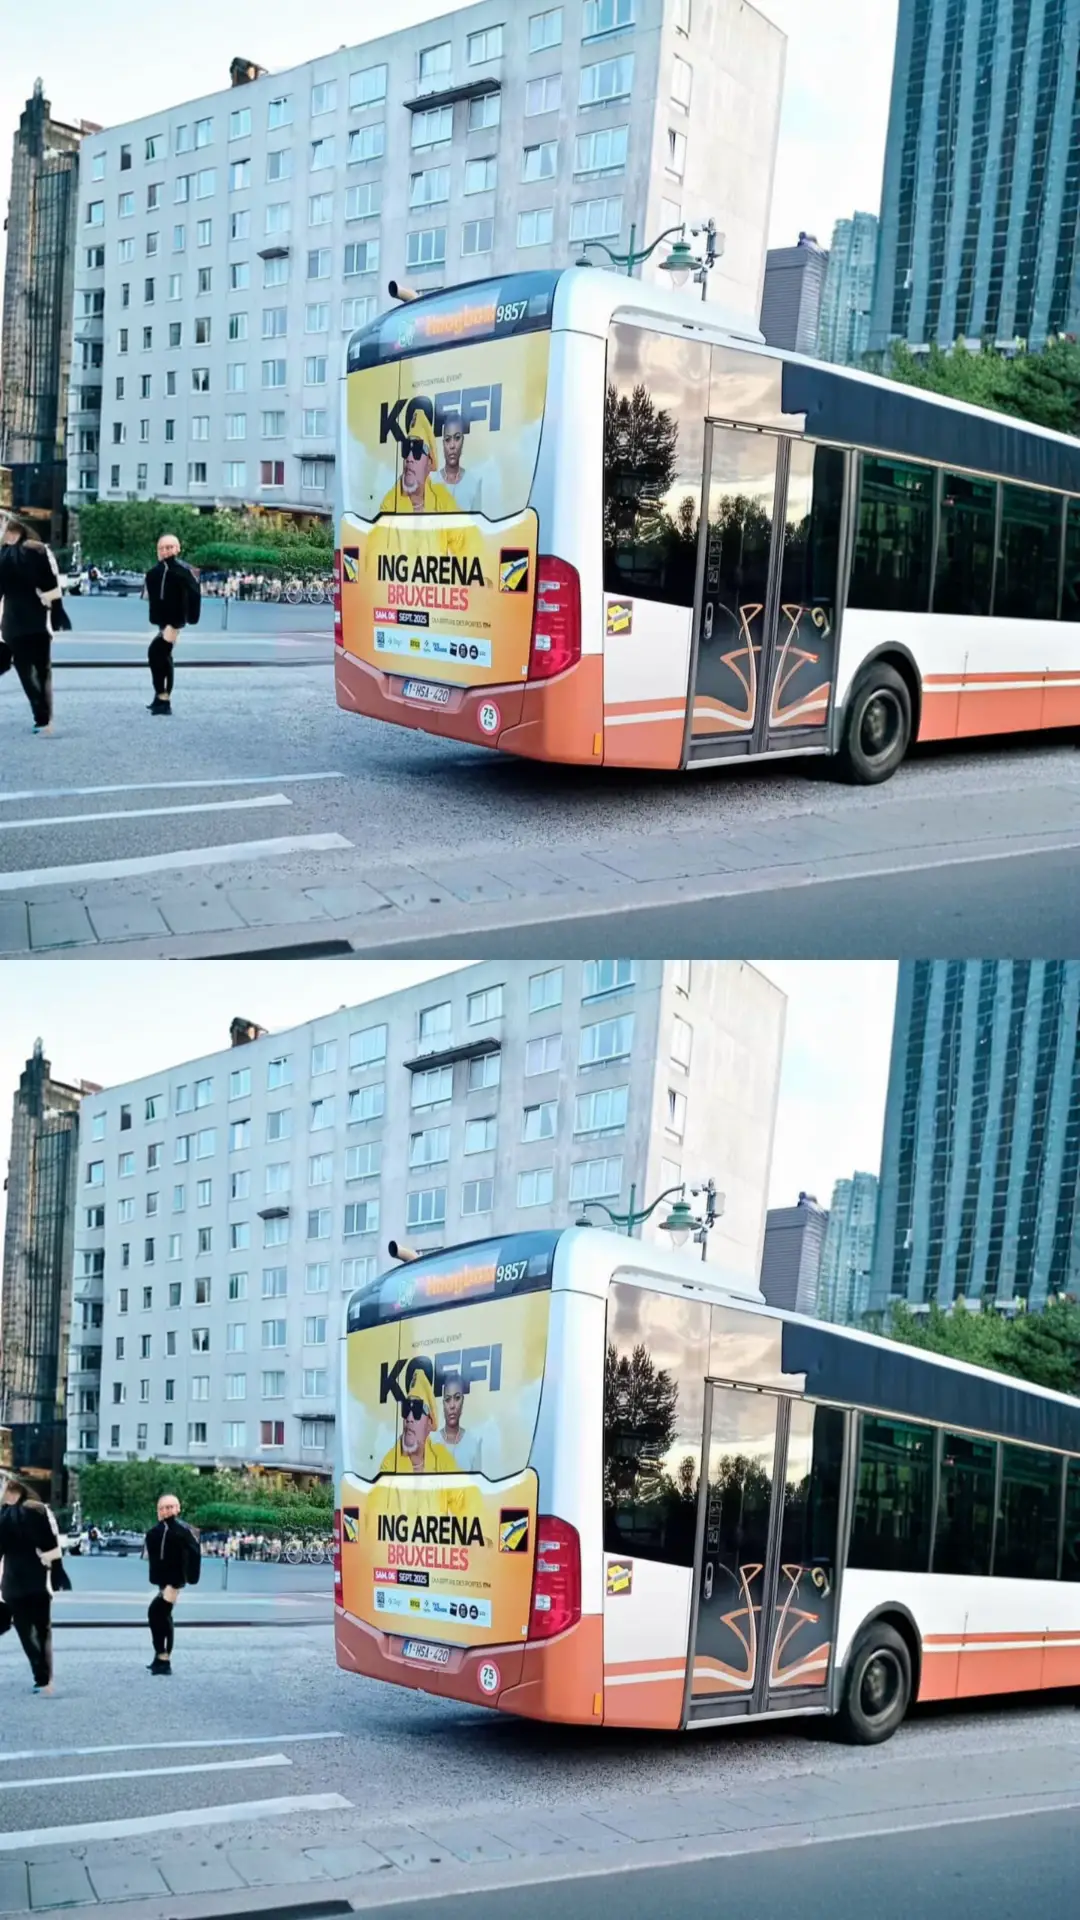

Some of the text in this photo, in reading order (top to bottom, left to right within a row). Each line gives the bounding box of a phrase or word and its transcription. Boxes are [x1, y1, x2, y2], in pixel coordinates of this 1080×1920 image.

[496, 301, 528, 323] 9857
[380, 383, 502, 444] KOFFI
[377, 554, 485, 587] ING ARENA
[387, 583, 469, 612] BRUXELLES
[413, 614, 427, 624] 2025
[483, 707, 494, 719] 75
[496, 1261, 528, 1283] 9857
[380, 1343, 502, 1404] KOFFI
[377, 1514, 485, 1547] ING ARENA
[387, 1543, 469, 1572] BRUXELLES
[413, 1574, 427, 1584] 2025
[483, 1667, 494, 1679] 75
